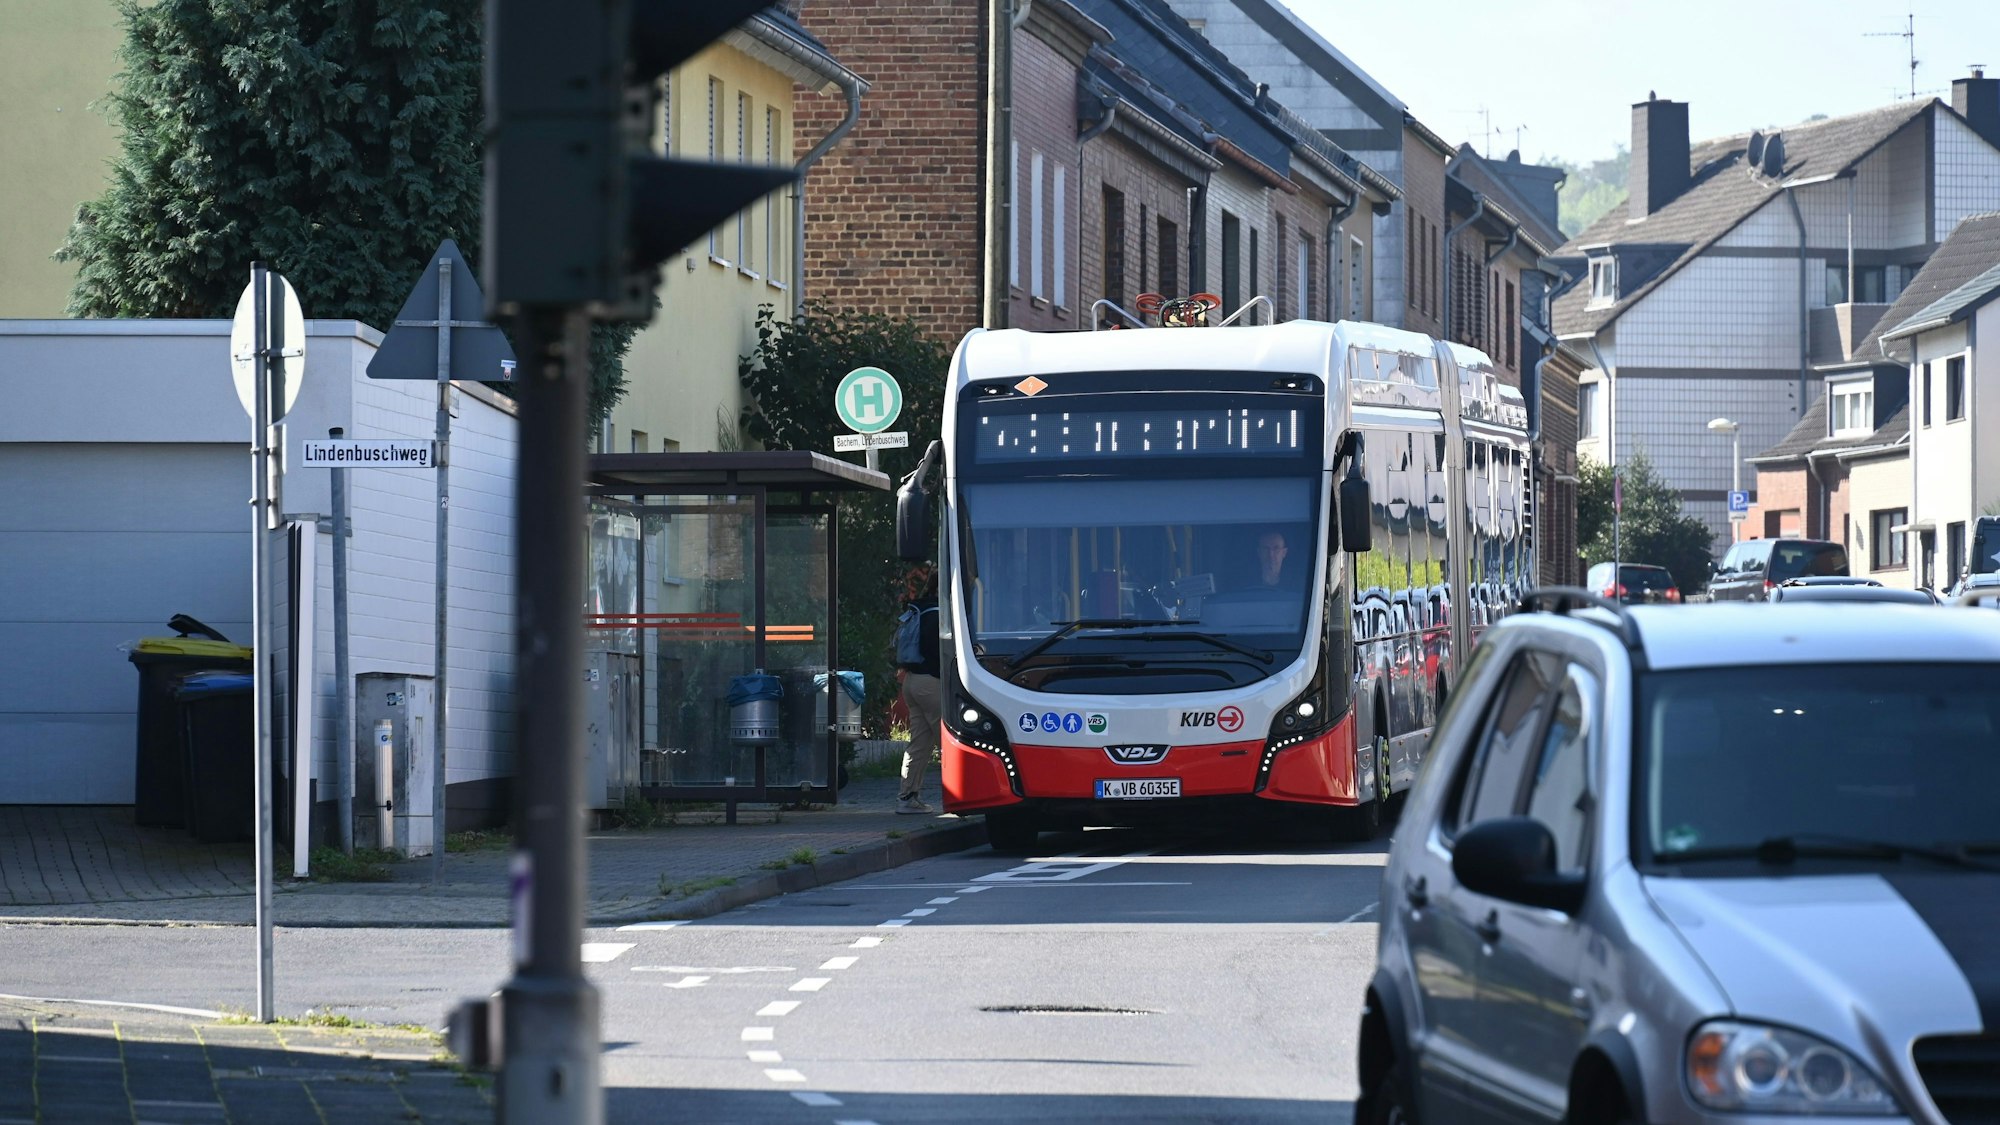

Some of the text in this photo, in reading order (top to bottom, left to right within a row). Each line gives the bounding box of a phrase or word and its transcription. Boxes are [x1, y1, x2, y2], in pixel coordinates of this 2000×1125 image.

[854, 383, 884, 418] H
[837, 437, 860, 448] Bachem,
[305, 444, 427, 465] Lindenbuschweg
[1088, 717, 1103, 725] VRS
[1180, 711, 1216, 727] KVB
[1115, 747, 1159, 759] VDL
[1104, 781, 1178, 796] K VB 6035E
